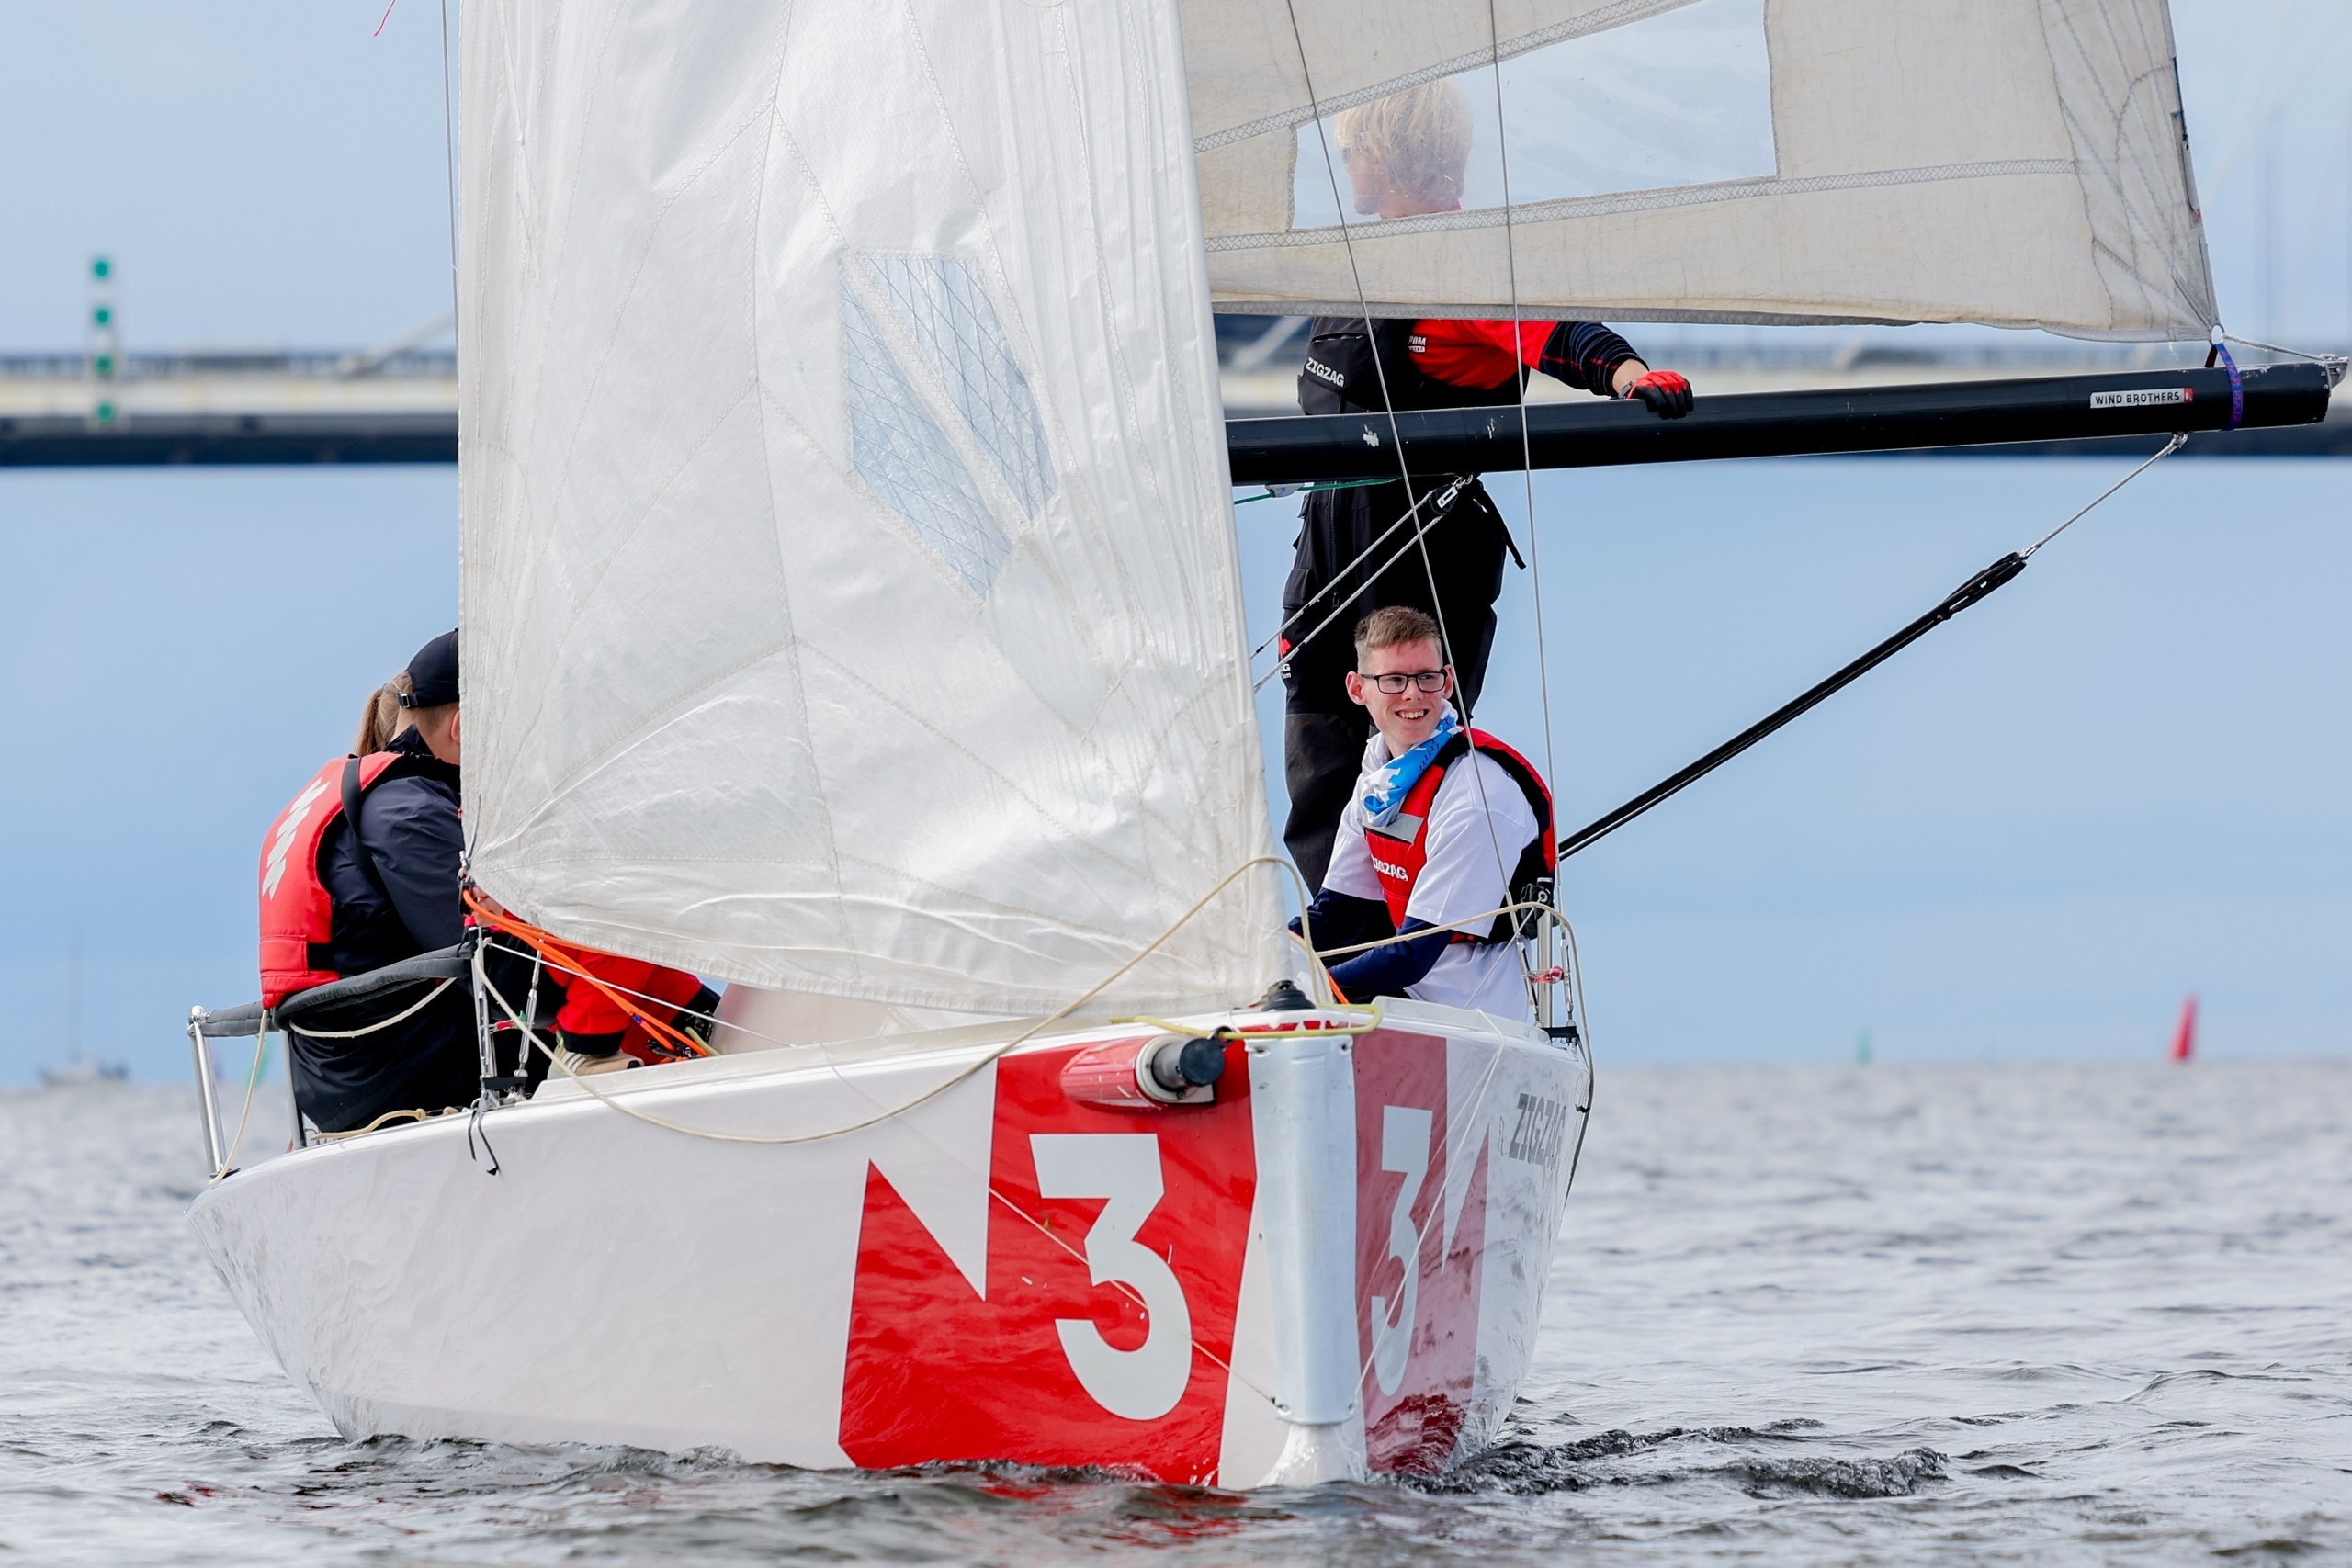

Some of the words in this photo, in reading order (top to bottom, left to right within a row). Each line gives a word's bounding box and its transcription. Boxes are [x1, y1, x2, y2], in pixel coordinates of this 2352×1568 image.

[1305, 356, 1345, 388] ZIGZAG
[2095, 394, 2122, 405] WIND
[2126, 391, 2180, 404] BROTHERS
[1029, 1133, 1193, 1422] 3
[1371, 1105, 1433, 1397] 3
